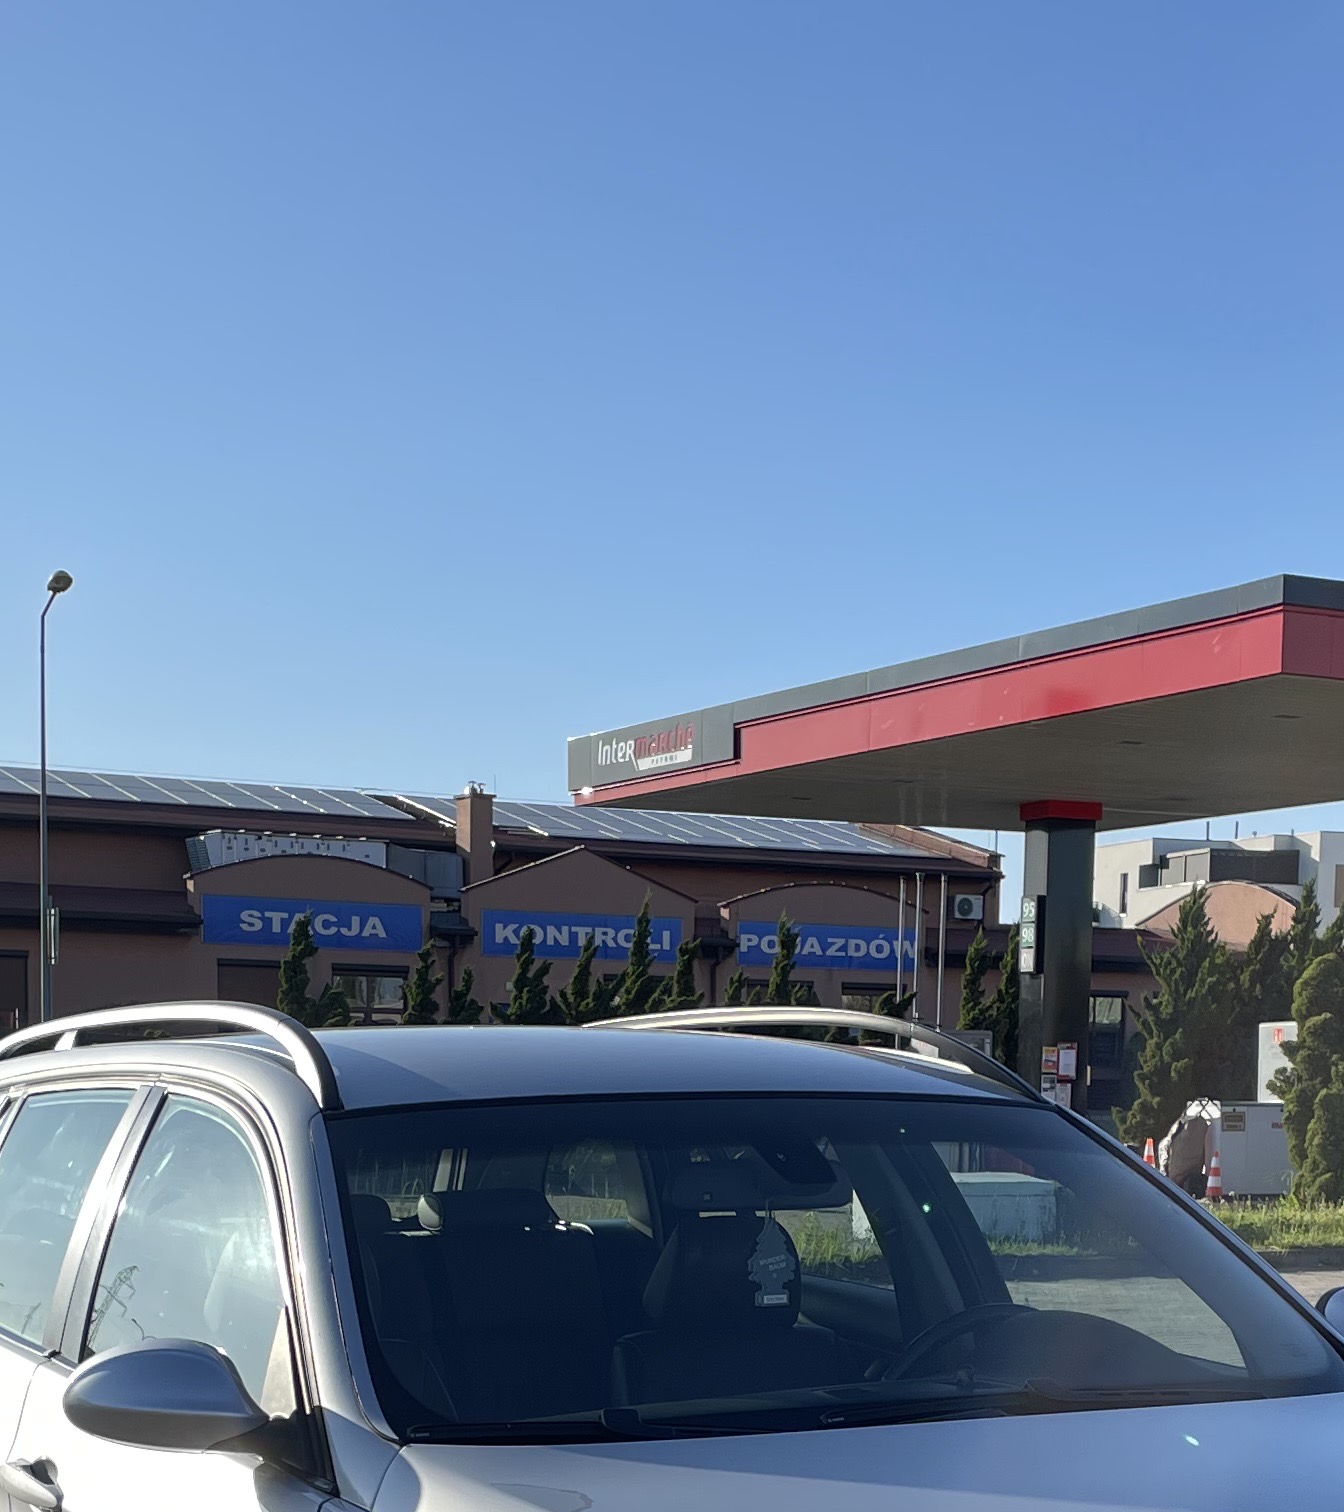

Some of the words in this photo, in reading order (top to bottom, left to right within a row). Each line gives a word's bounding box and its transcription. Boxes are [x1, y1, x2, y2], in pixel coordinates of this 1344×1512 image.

[1023, 902, 1035, 918] 95
[239, 909, 388, 939] STACJA
[494, 922, 671, 951] KONTROLI
[1022, 927, 1034, 943] 98
